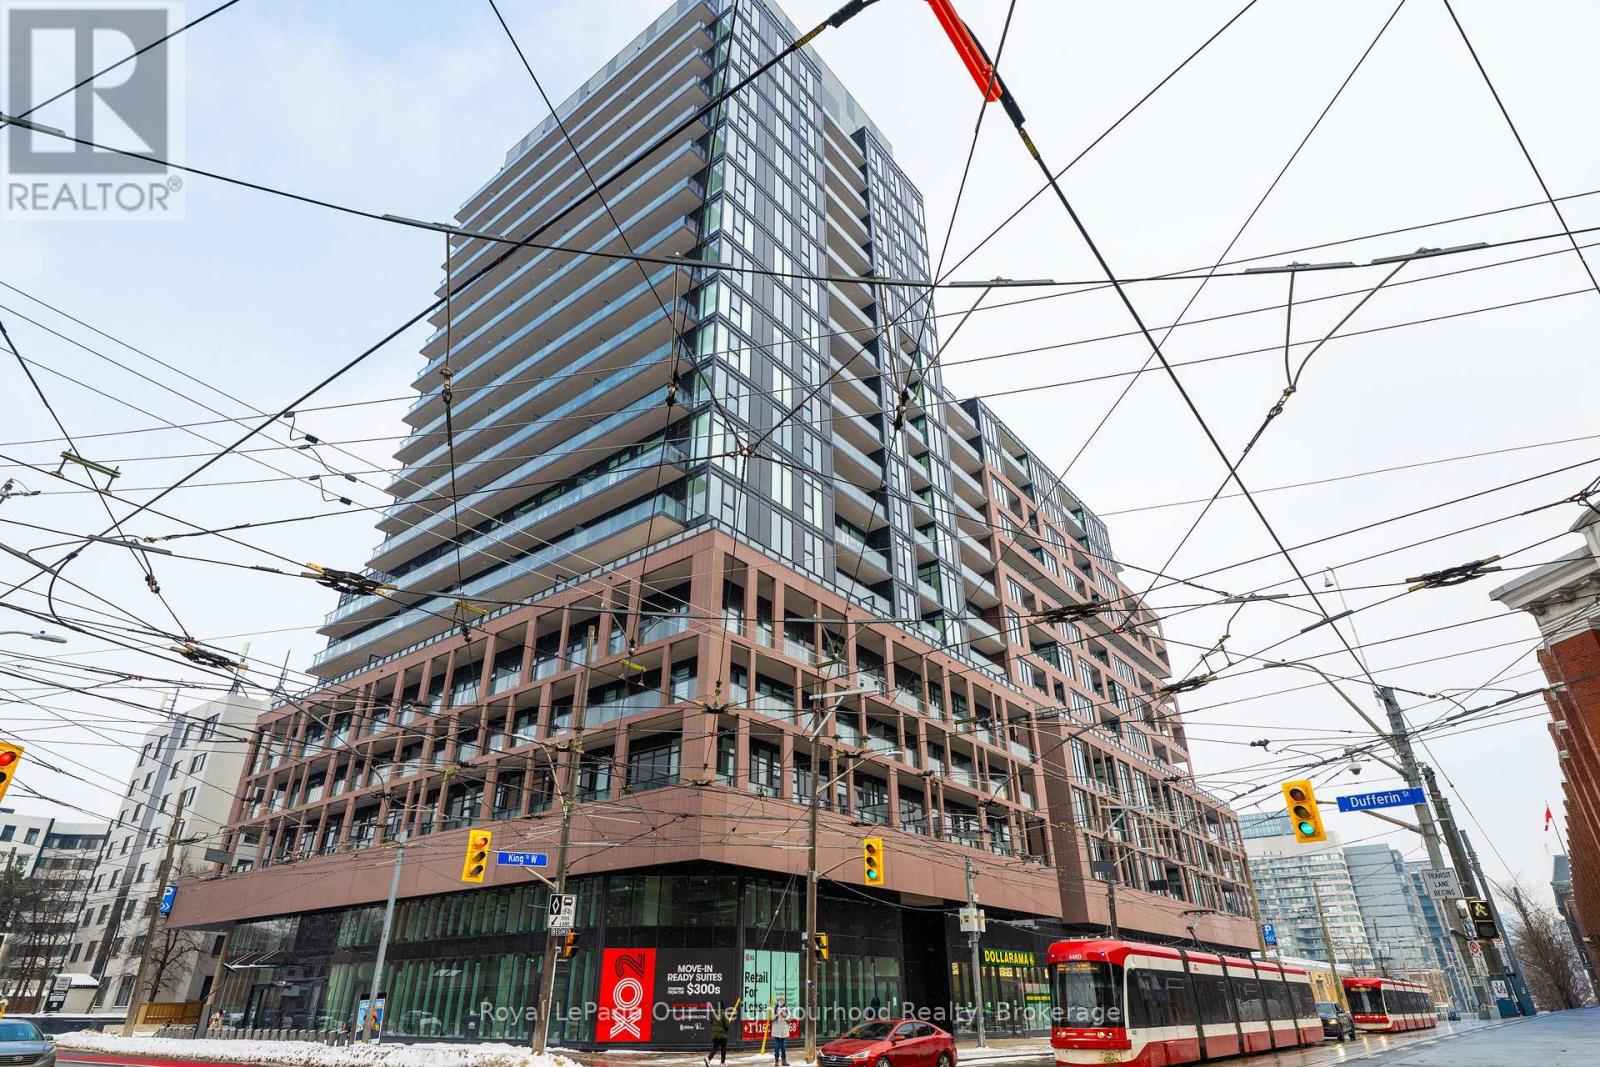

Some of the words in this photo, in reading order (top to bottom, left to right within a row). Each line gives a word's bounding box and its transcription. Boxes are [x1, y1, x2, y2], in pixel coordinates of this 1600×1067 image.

[1350, 792, 1401, 808] Dufferin
[1402, 790, 1410, 798] St
[508, 853, 524, 865] King
[530, 855, 538, 864] W
[1427, 871, 1451, 879] TRANSIT
[1433, 880, 1450, 888] LANE
[163, 886, 174, 900] P
[1433, 889, 1456, 897] BEGINS
[1264, 925, 1272, 936] P
[984, 950, 1029, 964] DOLLARAMA
[677, 964, 713, 973] MOVE-IN
[667, 973, 694, 982] READY
[695, 973, 723, 982] SUITES
[744, 971, 769, 984] Retail
[686, 982, 721, 996] $300s
[744, 986, 758, 998] For
